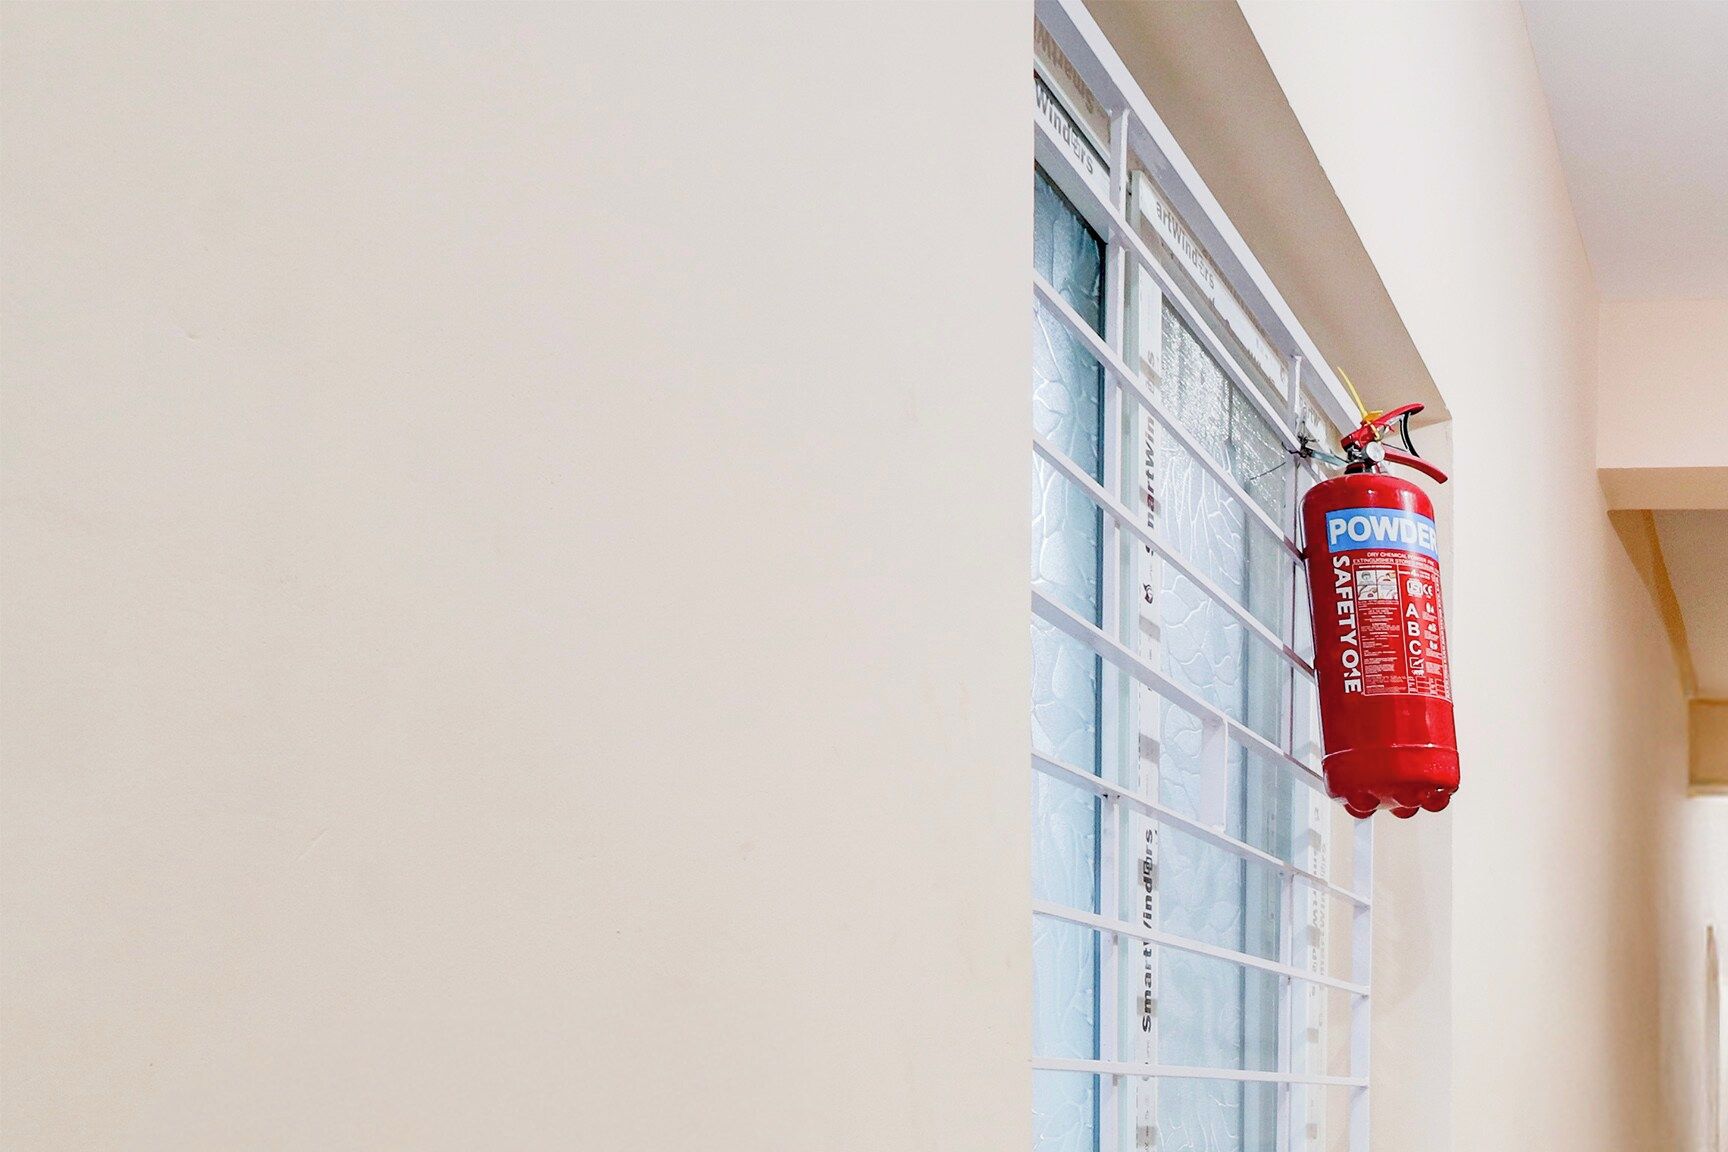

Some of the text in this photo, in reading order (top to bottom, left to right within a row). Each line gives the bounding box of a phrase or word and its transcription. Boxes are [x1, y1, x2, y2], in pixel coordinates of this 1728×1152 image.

[1329, 515, 1438, 552] POWDER
[1405, 602, 1419, 619] A
[1407, 621, 1421, 637] B
[1408, 639, 1422, 656] C
